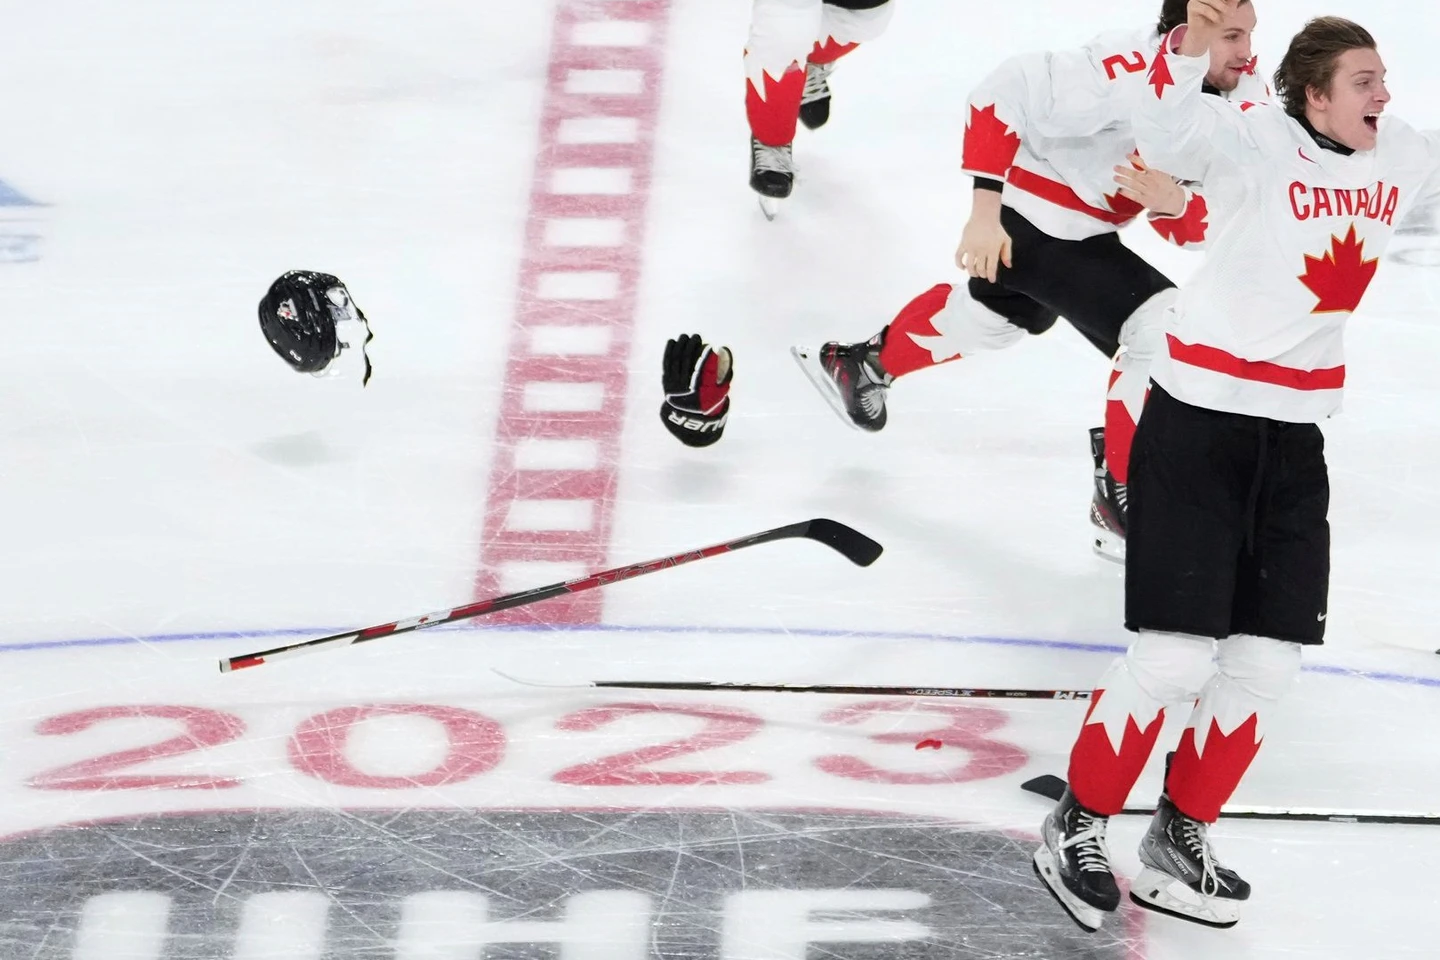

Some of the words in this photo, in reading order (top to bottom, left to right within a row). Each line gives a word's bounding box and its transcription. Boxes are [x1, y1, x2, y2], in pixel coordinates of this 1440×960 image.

[1287, 179, 1400, 228] CANADA
[25, 700, 1030, 791] 2023
[1164, 845, 1190, 877] BAUER
